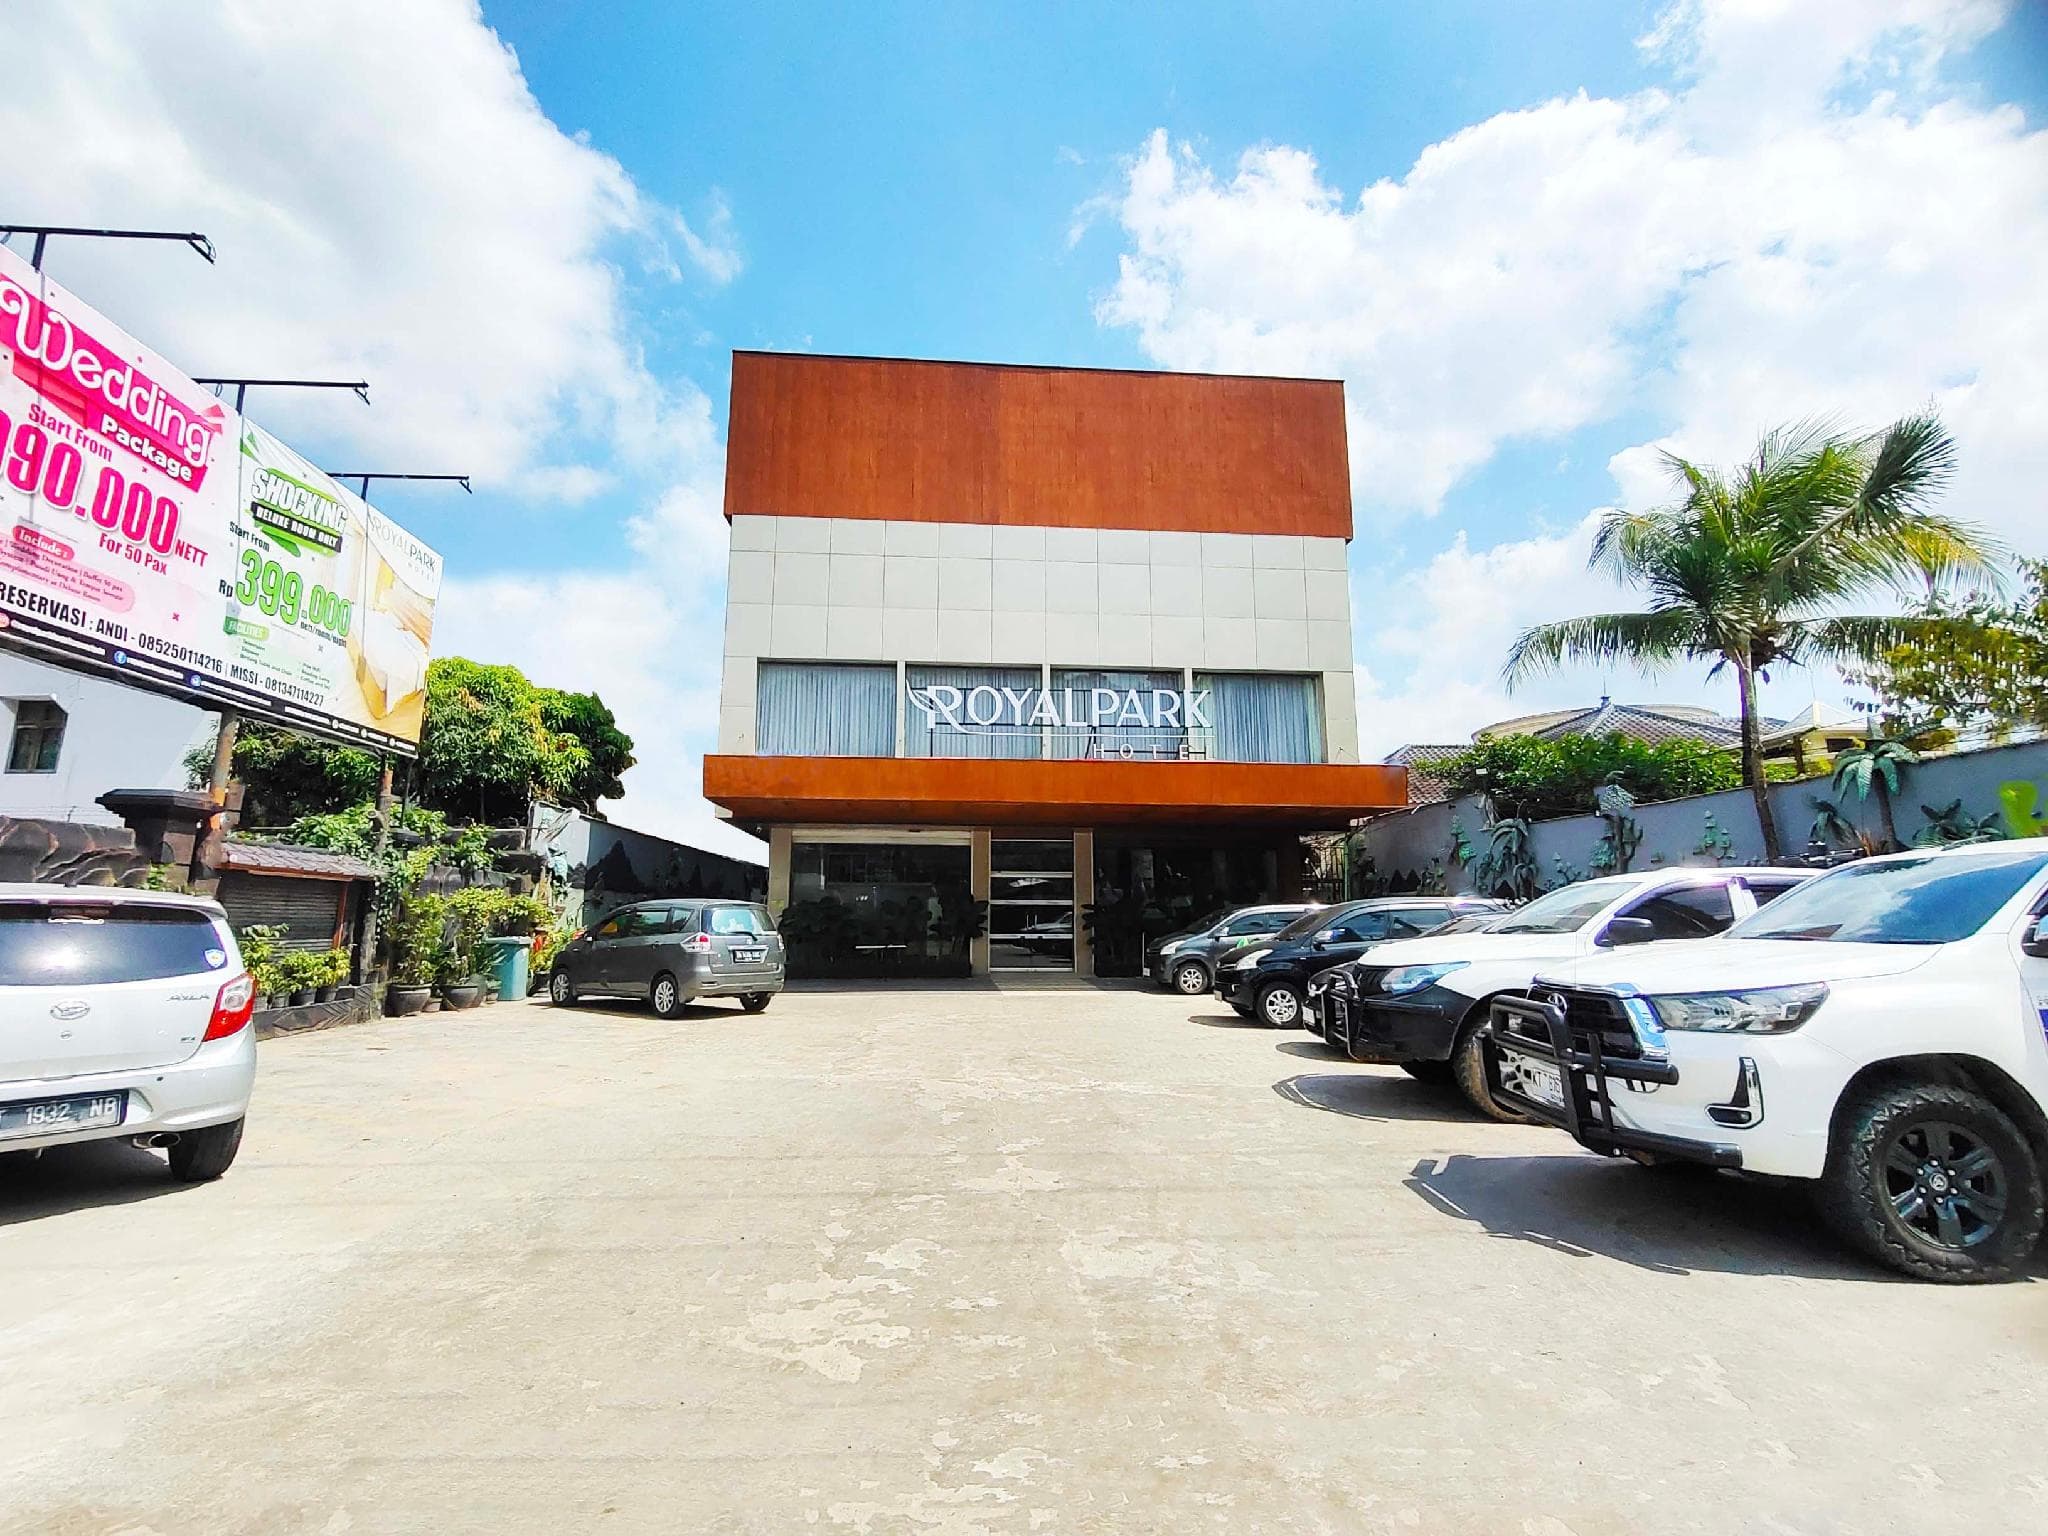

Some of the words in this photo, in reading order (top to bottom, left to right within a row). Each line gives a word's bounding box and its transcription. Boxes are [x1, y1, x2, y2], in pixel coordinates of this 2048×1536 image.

[0, 280, 210, 467] Wedding
[28, 403, 71, 438] Start
[75, 430, 113, 462] From
[100, 413, 193, 481] Package
[251, 467, 348, 535] SHOCKING
[20, 529, 62, 555] Include
[229, 520, 250, 541] Start
[251, 533, 270, 552] From
[256, 506, 290, 529] DELUXE
[290, 522, 317, 540] ROOM
[317, 530, 339, 548] ONLY
[99, 533, 122, 555] For
[124, 546, 142, 564] 50
[145, 552, 167, 575] Pax
[175, 539, 209, 567] NETT
[218, 578, 234, 597] Rp
[235, 548, 352, 638] 399.000
[96, 618, 128, 642] ANDI
[138, 632, 223, 673] 085250114216
[230, 663, 259, 685] MISSI
[265, 676, 324, 707] 081347114227
[907, 683, 1213, 733] ROYALPARK
[25, 1102, 72, 1125] 1932
